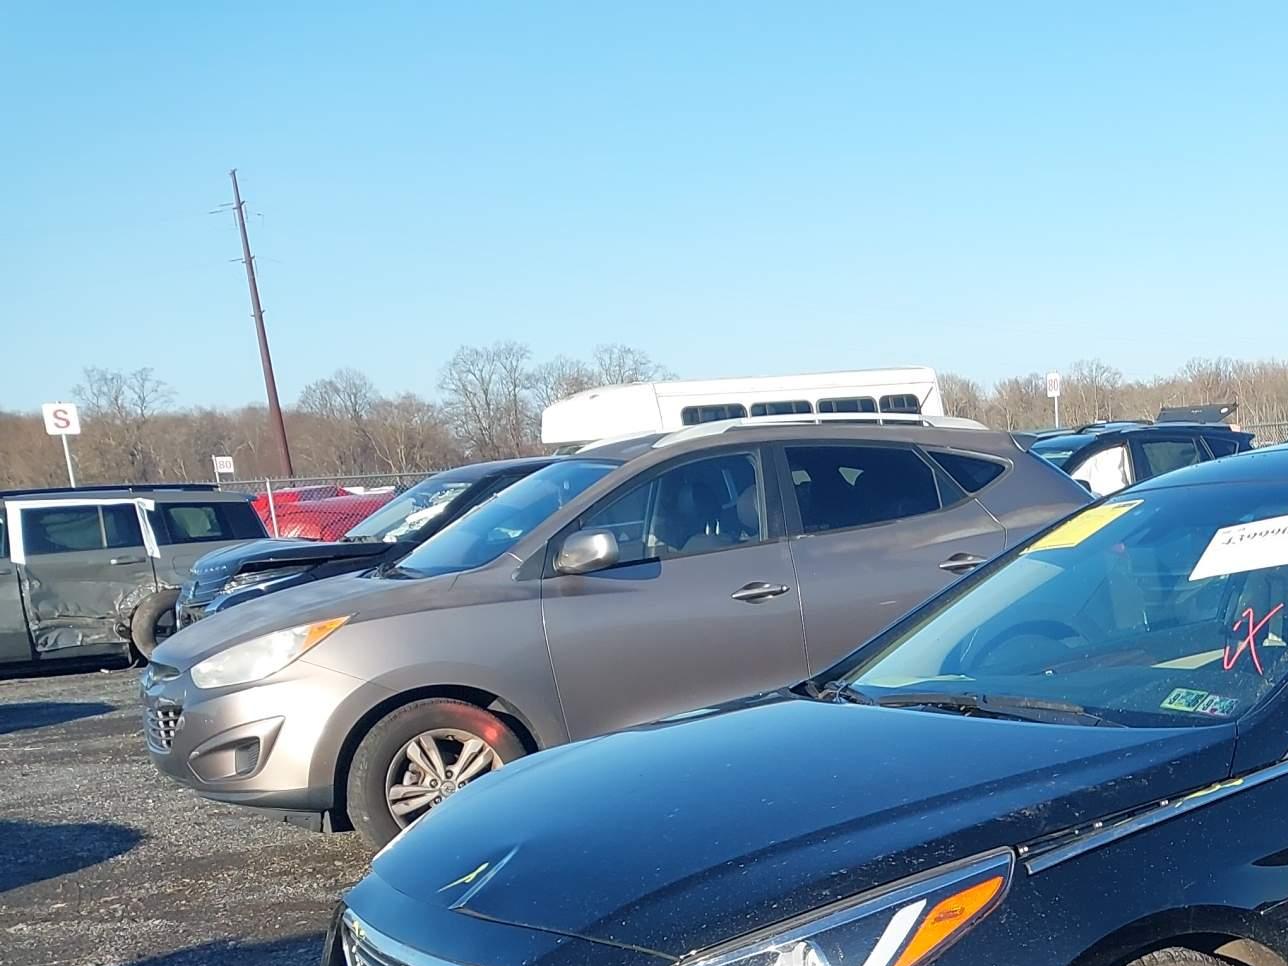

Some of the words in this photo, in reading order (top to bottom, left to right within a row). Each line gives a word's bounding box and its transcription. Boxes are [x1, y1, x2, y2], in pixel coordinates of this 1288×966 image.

[1048, 378, 1059, 392] 80
[52, 408, 71, 429] S
[218, 460, 232, 470] 80
